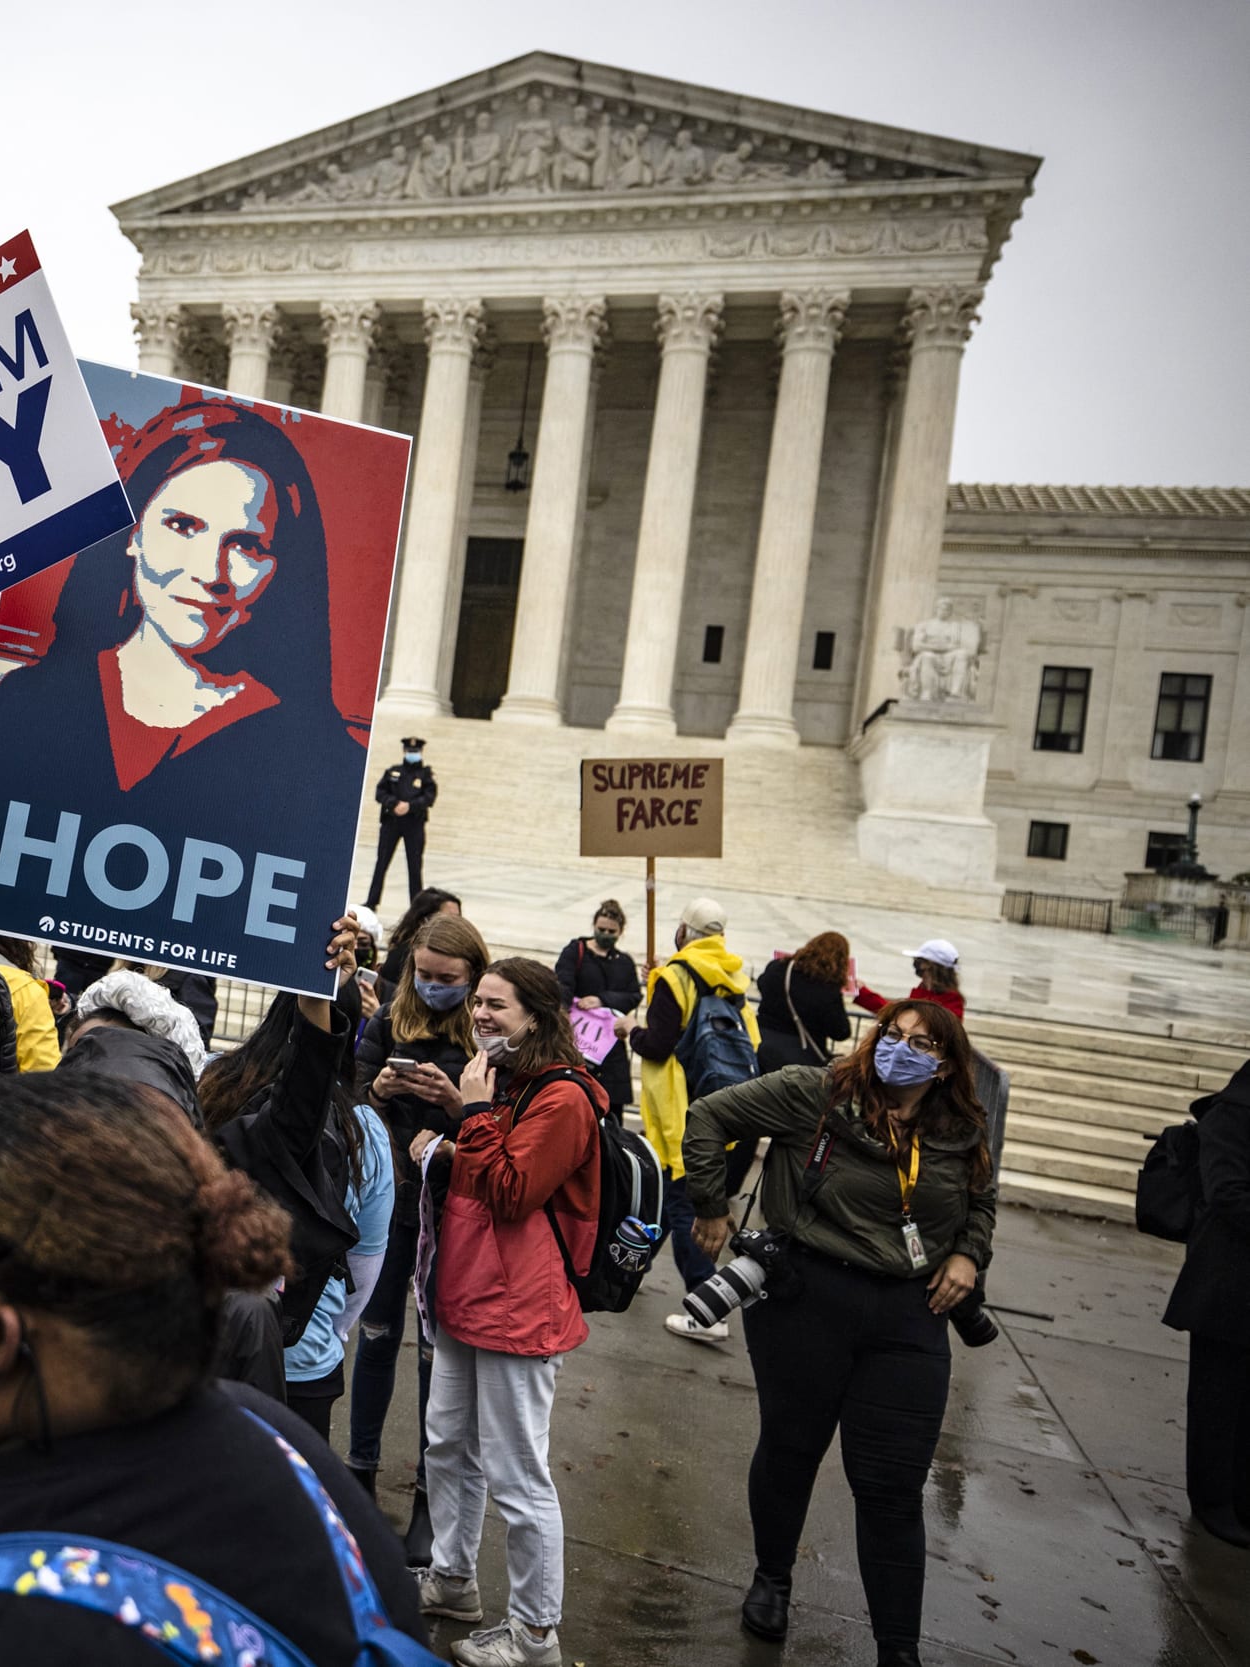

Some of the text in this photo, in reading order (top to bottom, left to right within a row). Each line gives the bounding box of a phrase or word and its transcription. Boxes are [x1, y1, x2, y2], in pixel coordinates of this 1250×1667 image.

[592, 762, 710, 792] SUPREME
[617, 797, 702, 832] FARCE
[58, 920, 237, 968] STUDENTS FOR LIFE
